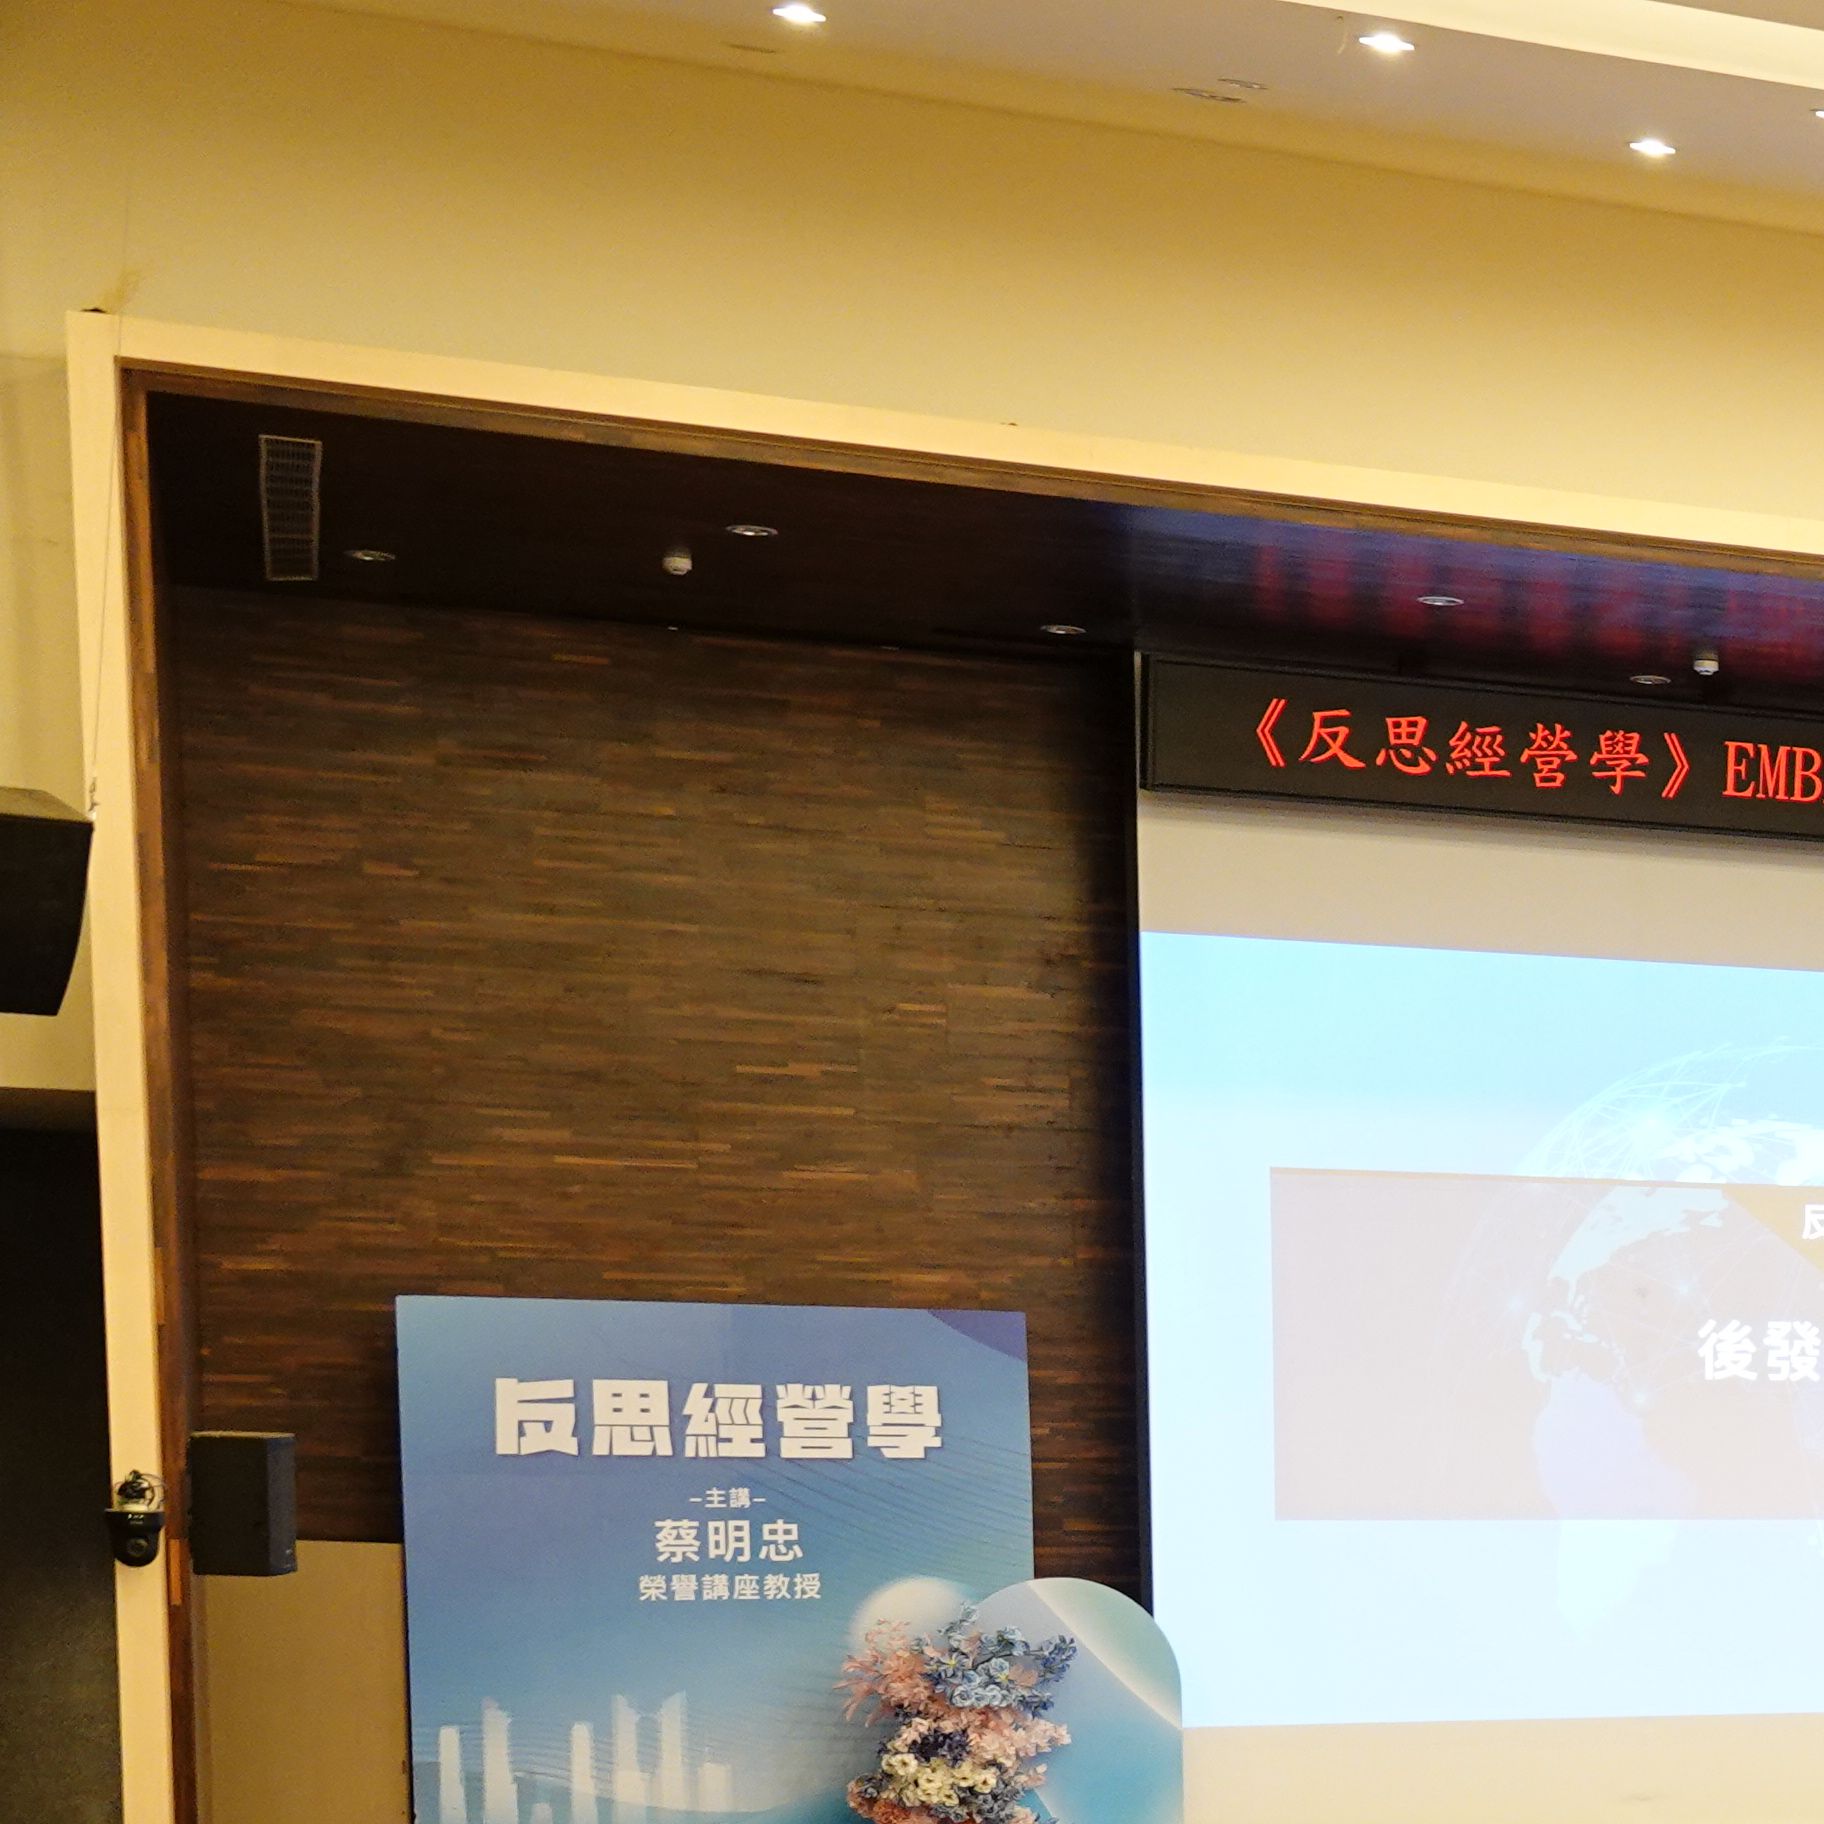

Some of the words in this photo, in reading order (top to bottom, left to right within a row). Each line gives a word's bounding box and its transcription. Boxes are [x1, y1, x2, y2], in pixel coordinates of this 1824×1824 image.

[495, 1377, 943, 1460] 反思經營學
[654, 1518, 803, 1563] 蔡明忠
[639, 1573, 822, 1602] 榮譽講座教授
